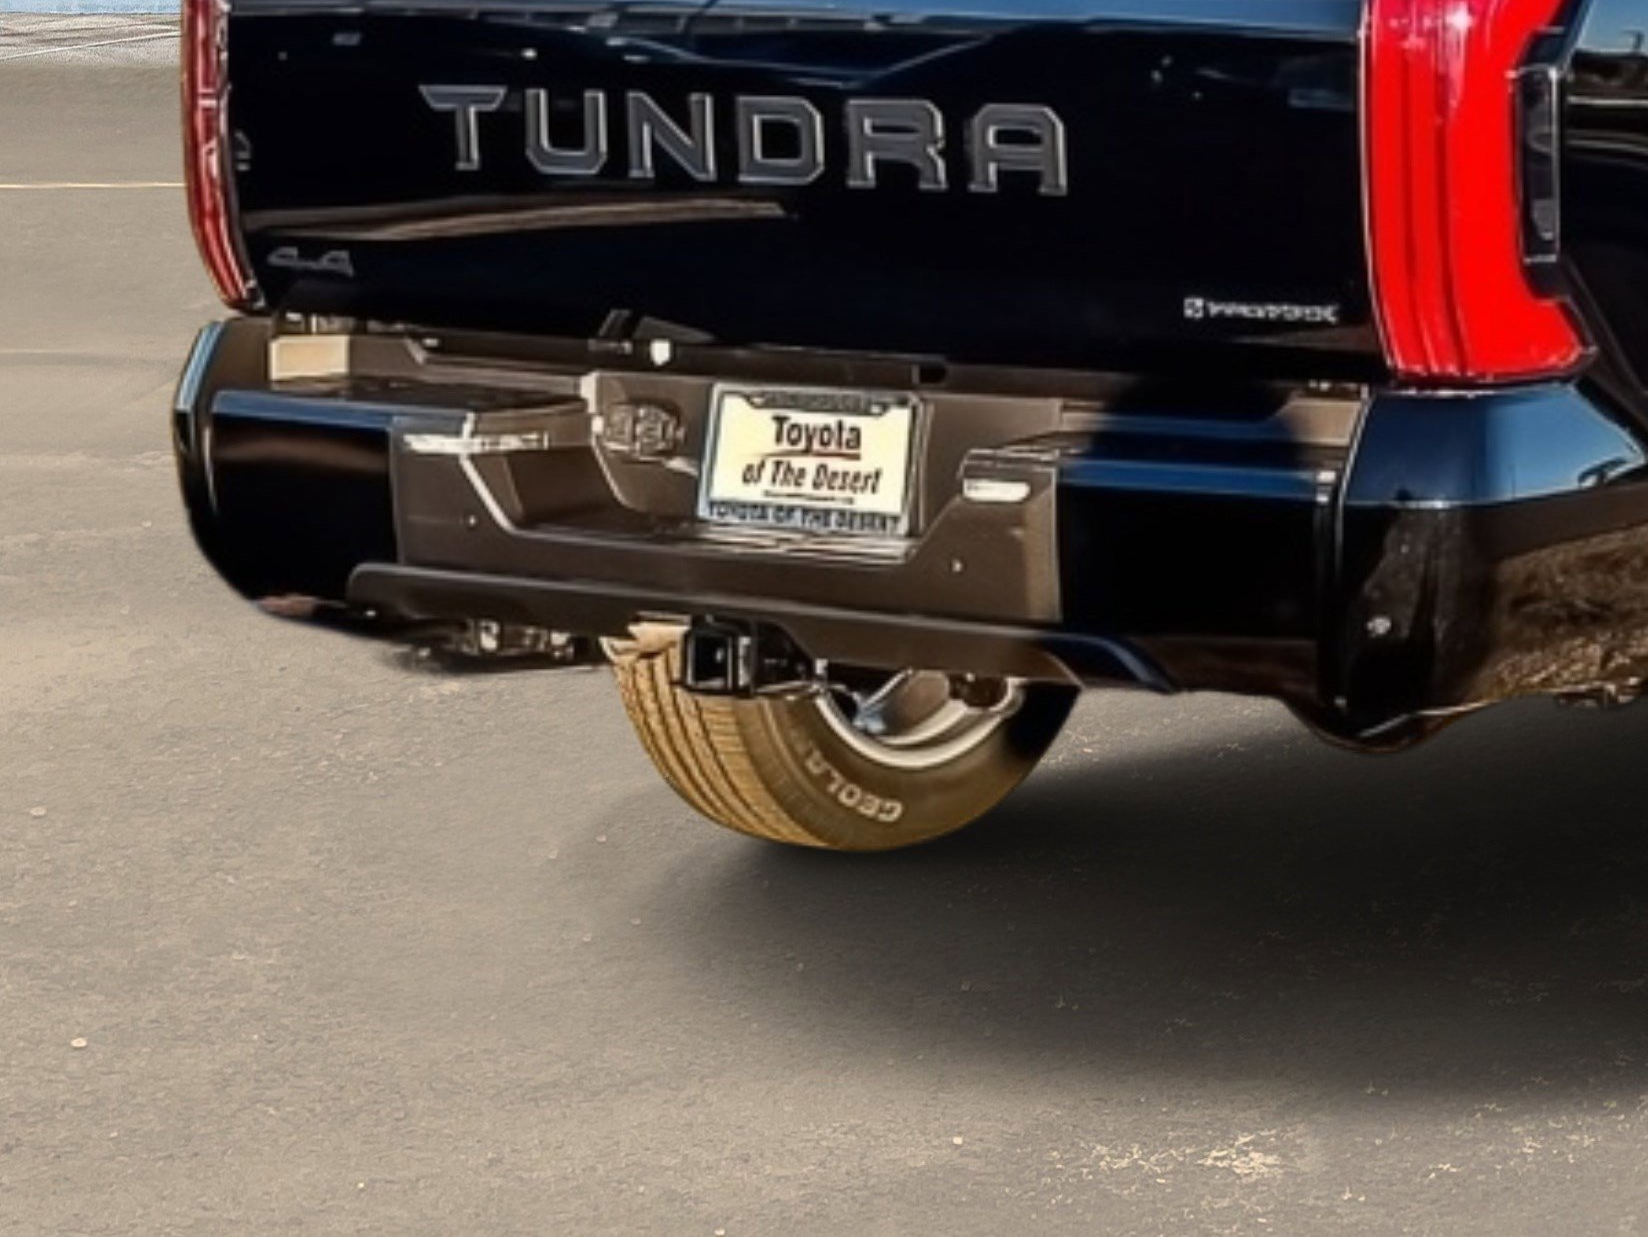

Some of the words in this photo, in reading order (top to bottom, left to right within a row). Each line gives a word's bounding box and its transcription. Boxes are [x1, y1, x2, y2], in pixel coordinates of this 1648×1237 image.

[418, 84, 1068, 196] TUNDRA
[772, 415, 861, 453] Toyota
[742, 459, 766, 485] of
[771, 460, 806, 487] The
[812, 464, 882, 494] Desert
